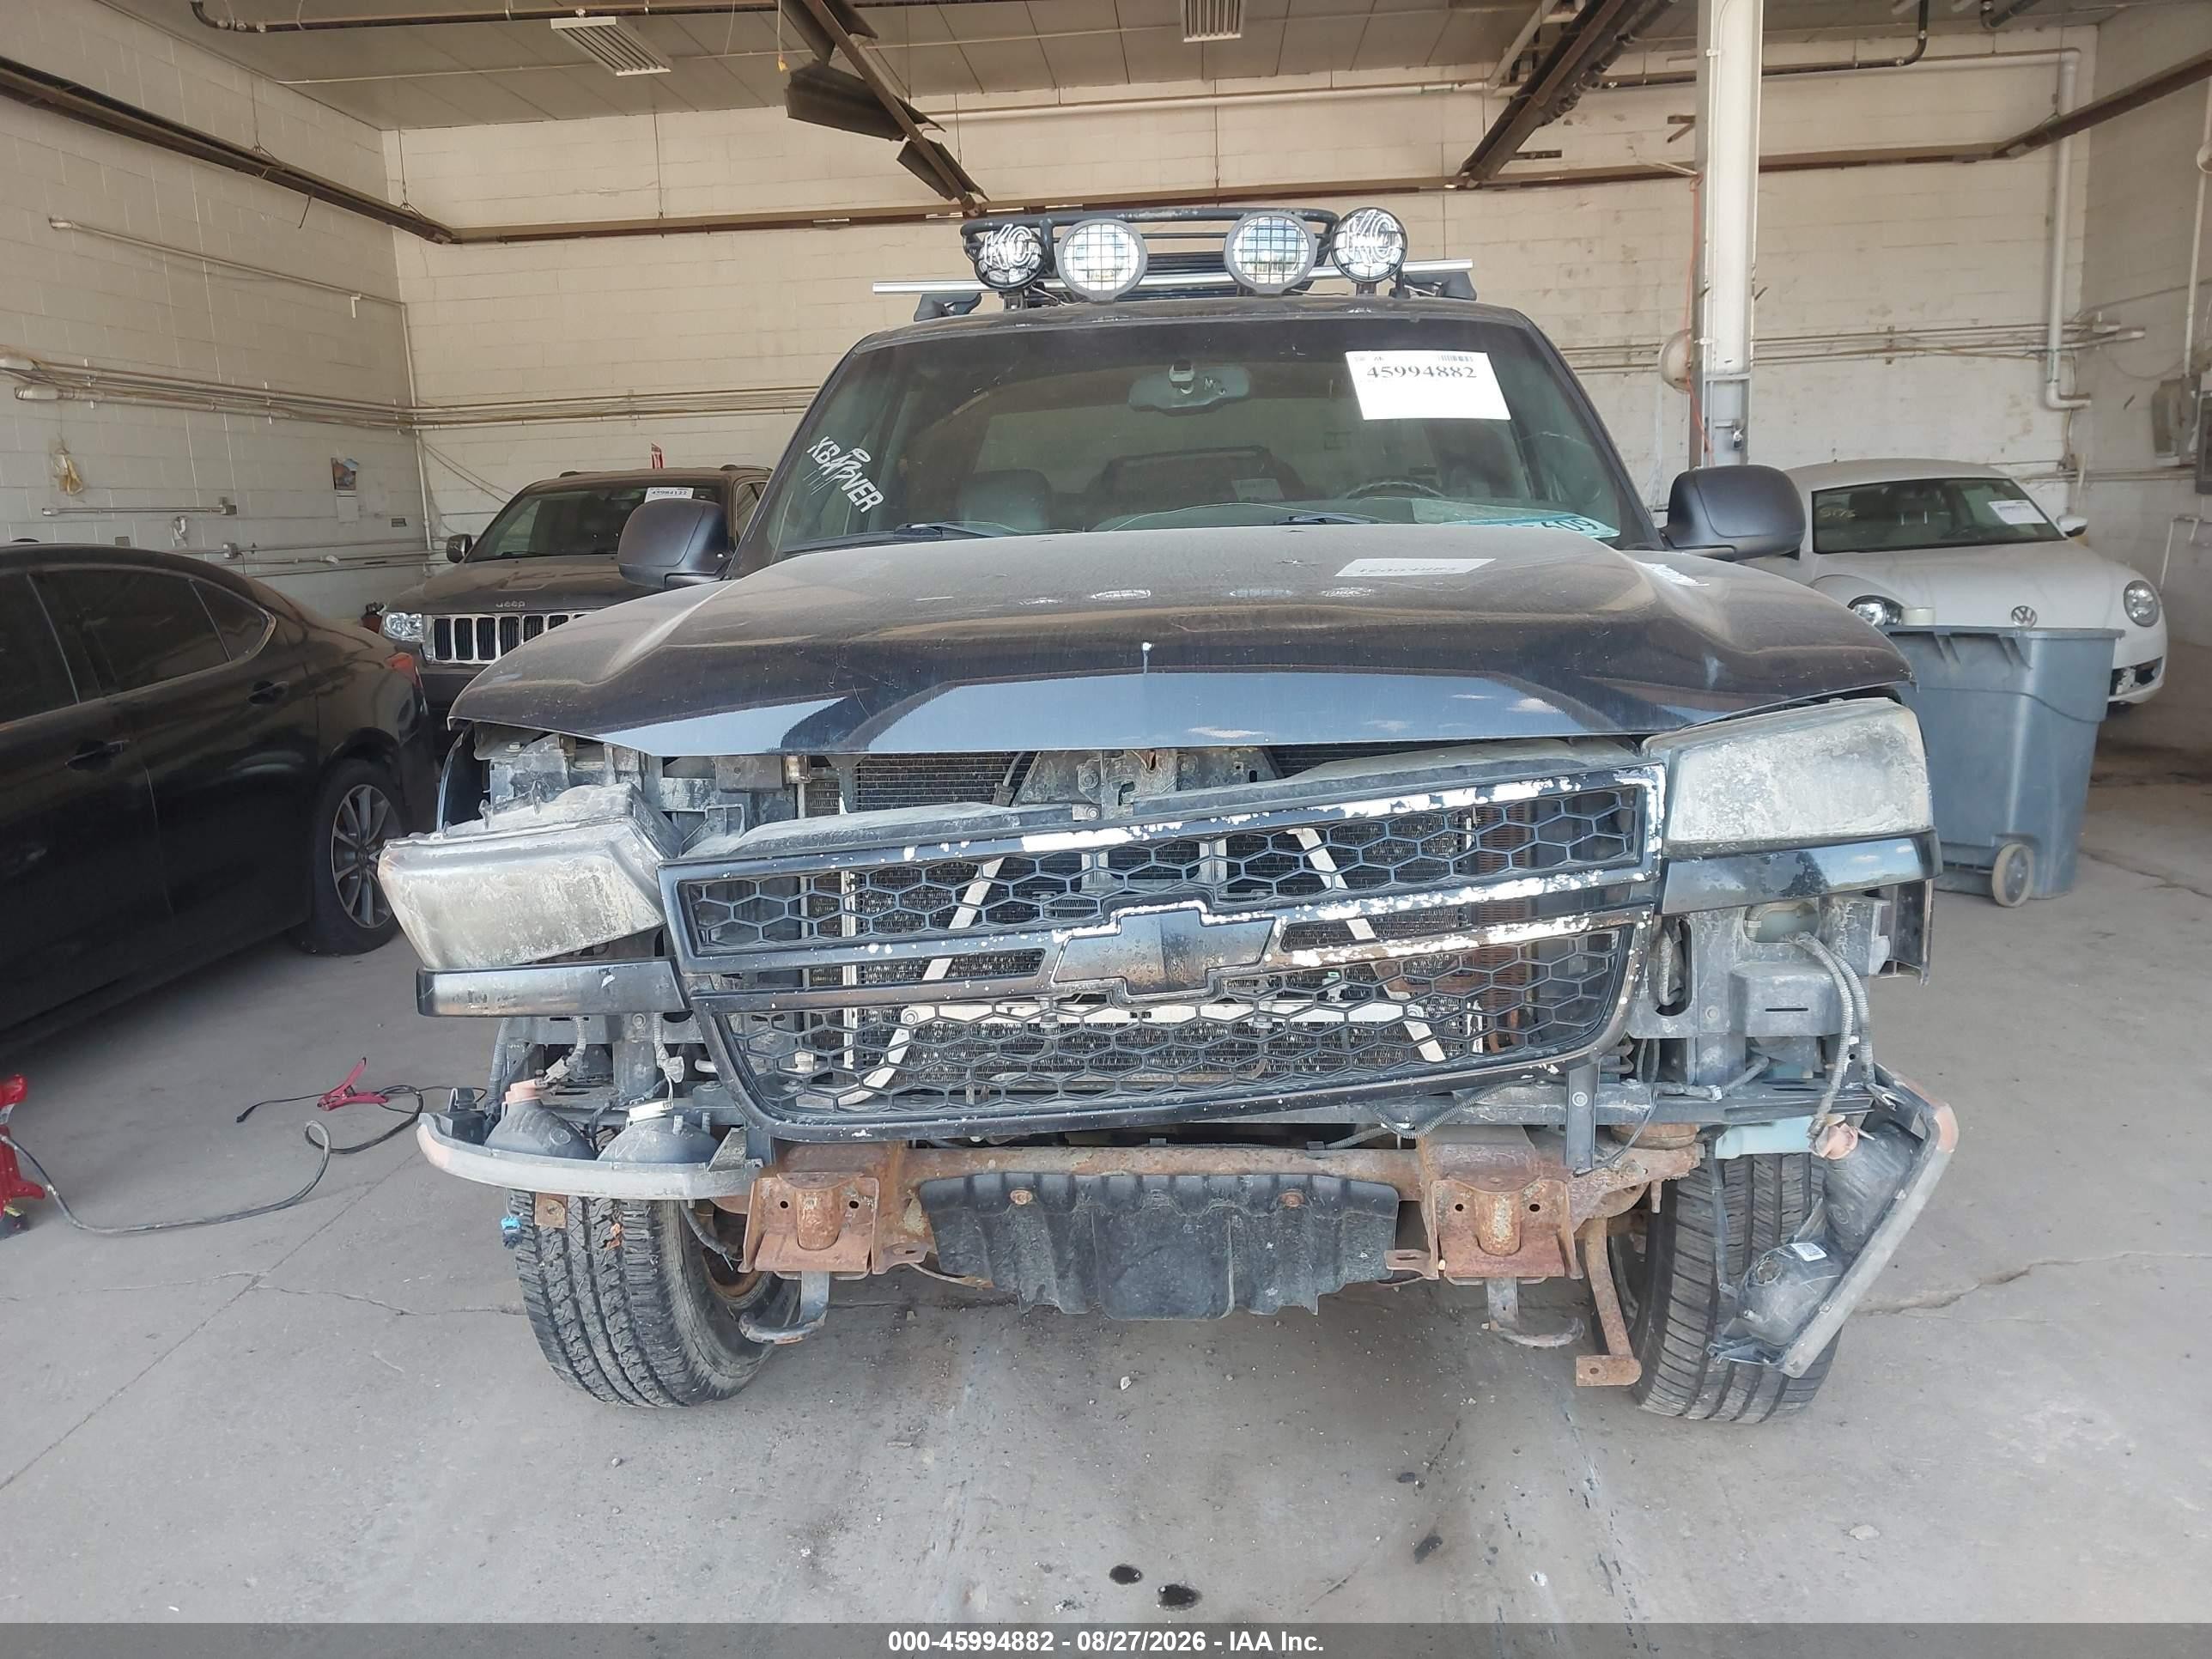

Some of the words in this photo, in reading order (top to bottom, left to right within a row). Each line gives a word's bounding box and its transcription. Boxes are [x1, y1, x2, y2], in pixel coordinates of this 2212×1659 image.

[984, 223, 1032, 270] KC
[1346, 209, 1398, 267] KC
[1367, 365, 1477, 379] 45994882
[495, 600, 526, 609] Jeep
